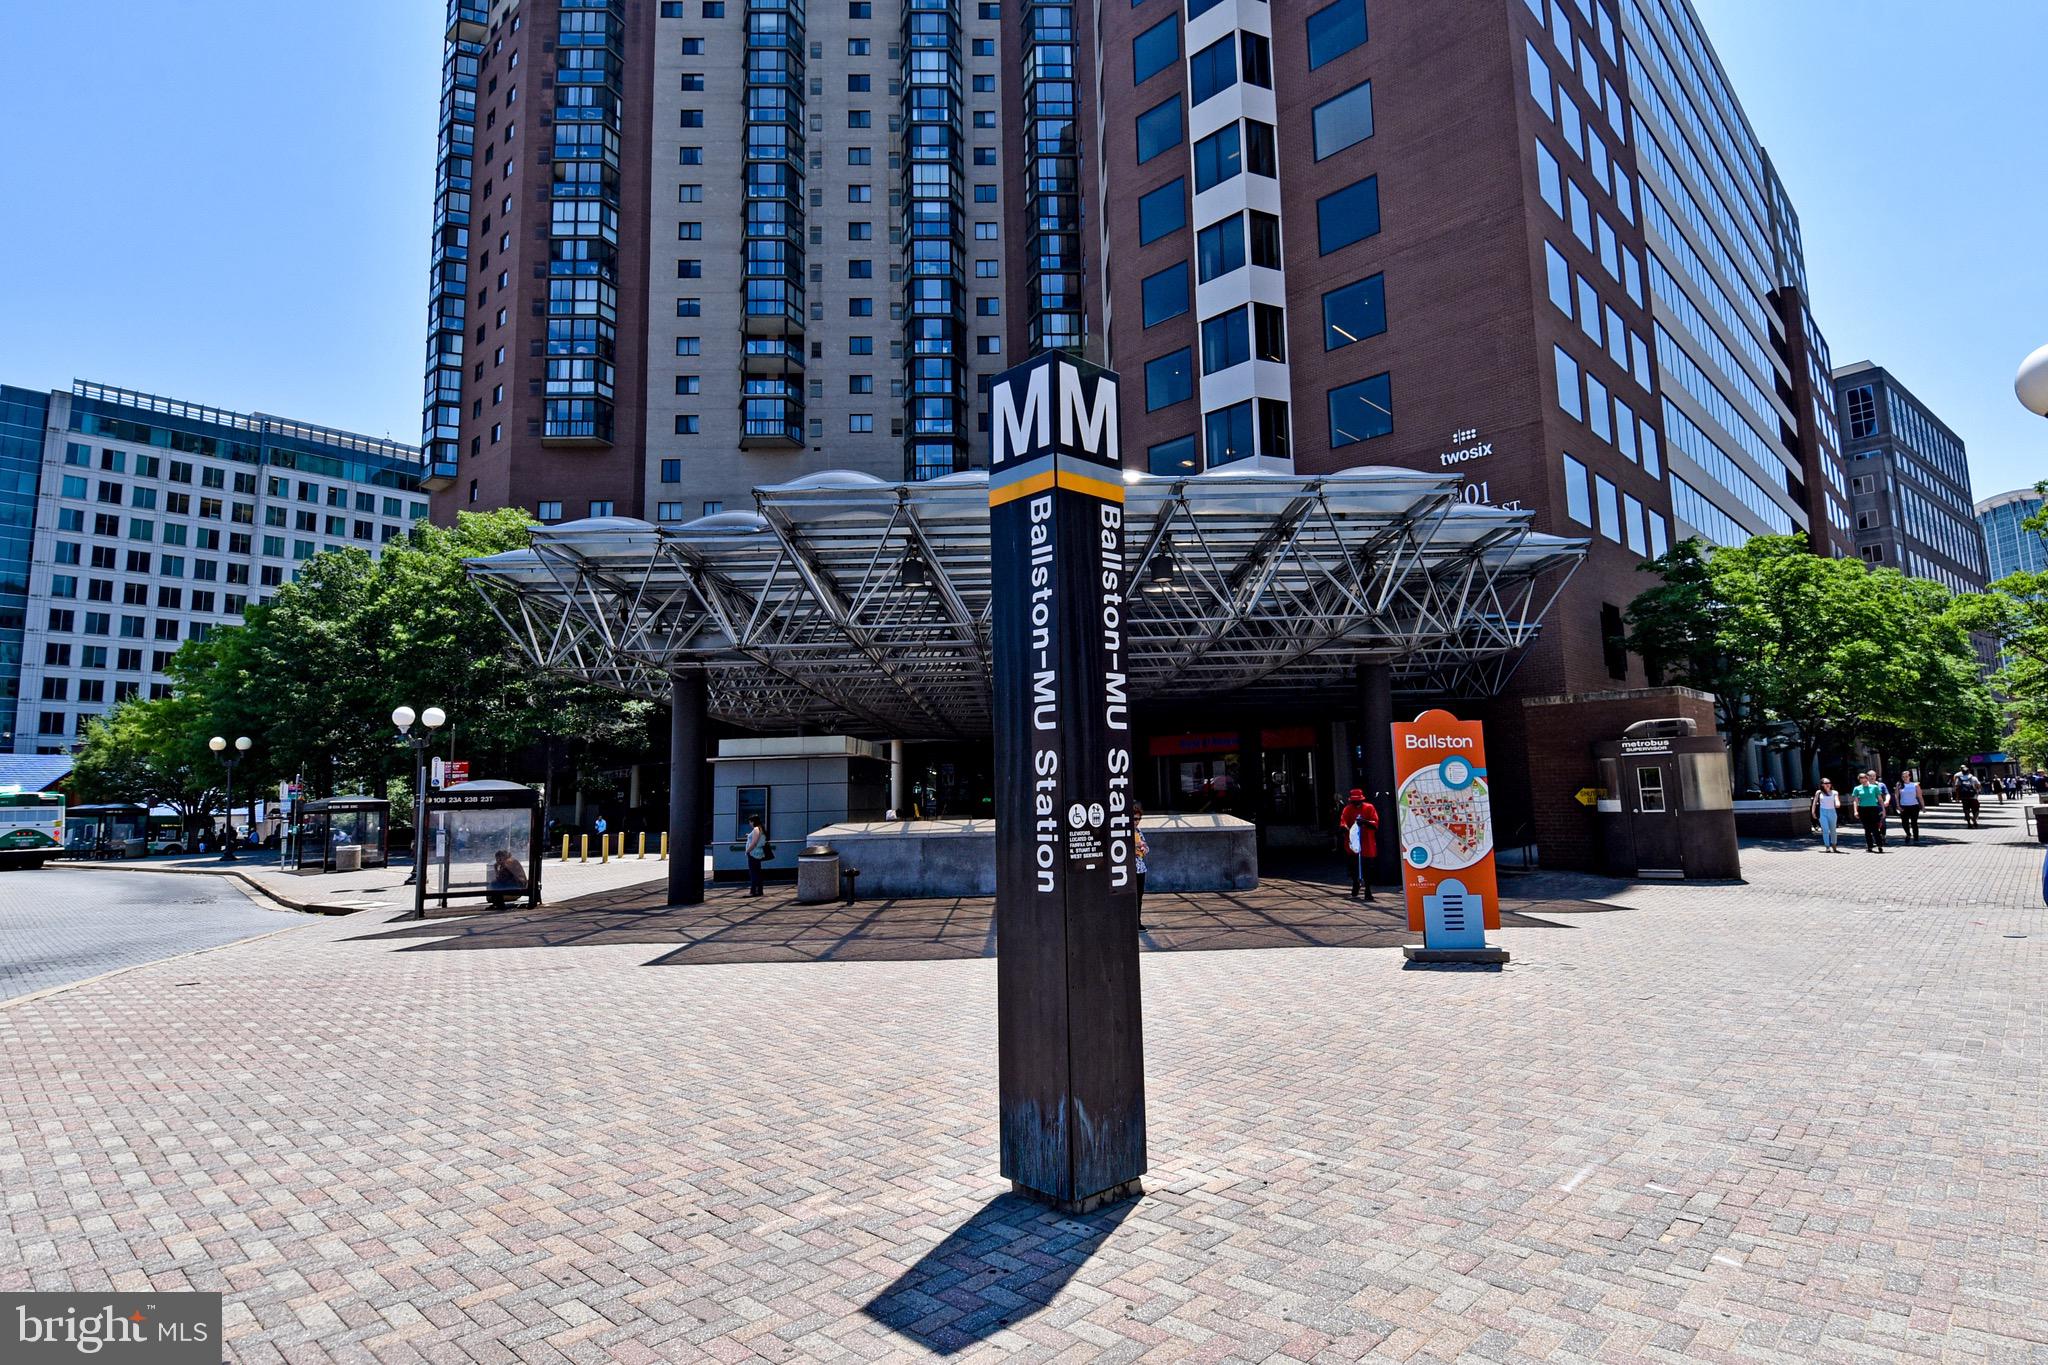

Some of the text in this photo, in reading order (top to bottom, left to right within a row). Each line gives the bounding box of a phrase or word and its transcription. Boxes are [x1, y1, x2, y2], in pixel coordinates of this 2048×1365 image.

[993, 363, 1049, 464] M
[1059, 361, 1118, 460] M
[1440, 442, 1492, 466] twosix
[1458, 481, 1490, 504] 01
[1030, 495, 1059, 893] Ballston-MU Station
[1101, 503, 1132, 887] Ballston-MU Station
[1405, 734, 1473, 749] Ballston
[1621, 740, 1669, 748] metrobus
